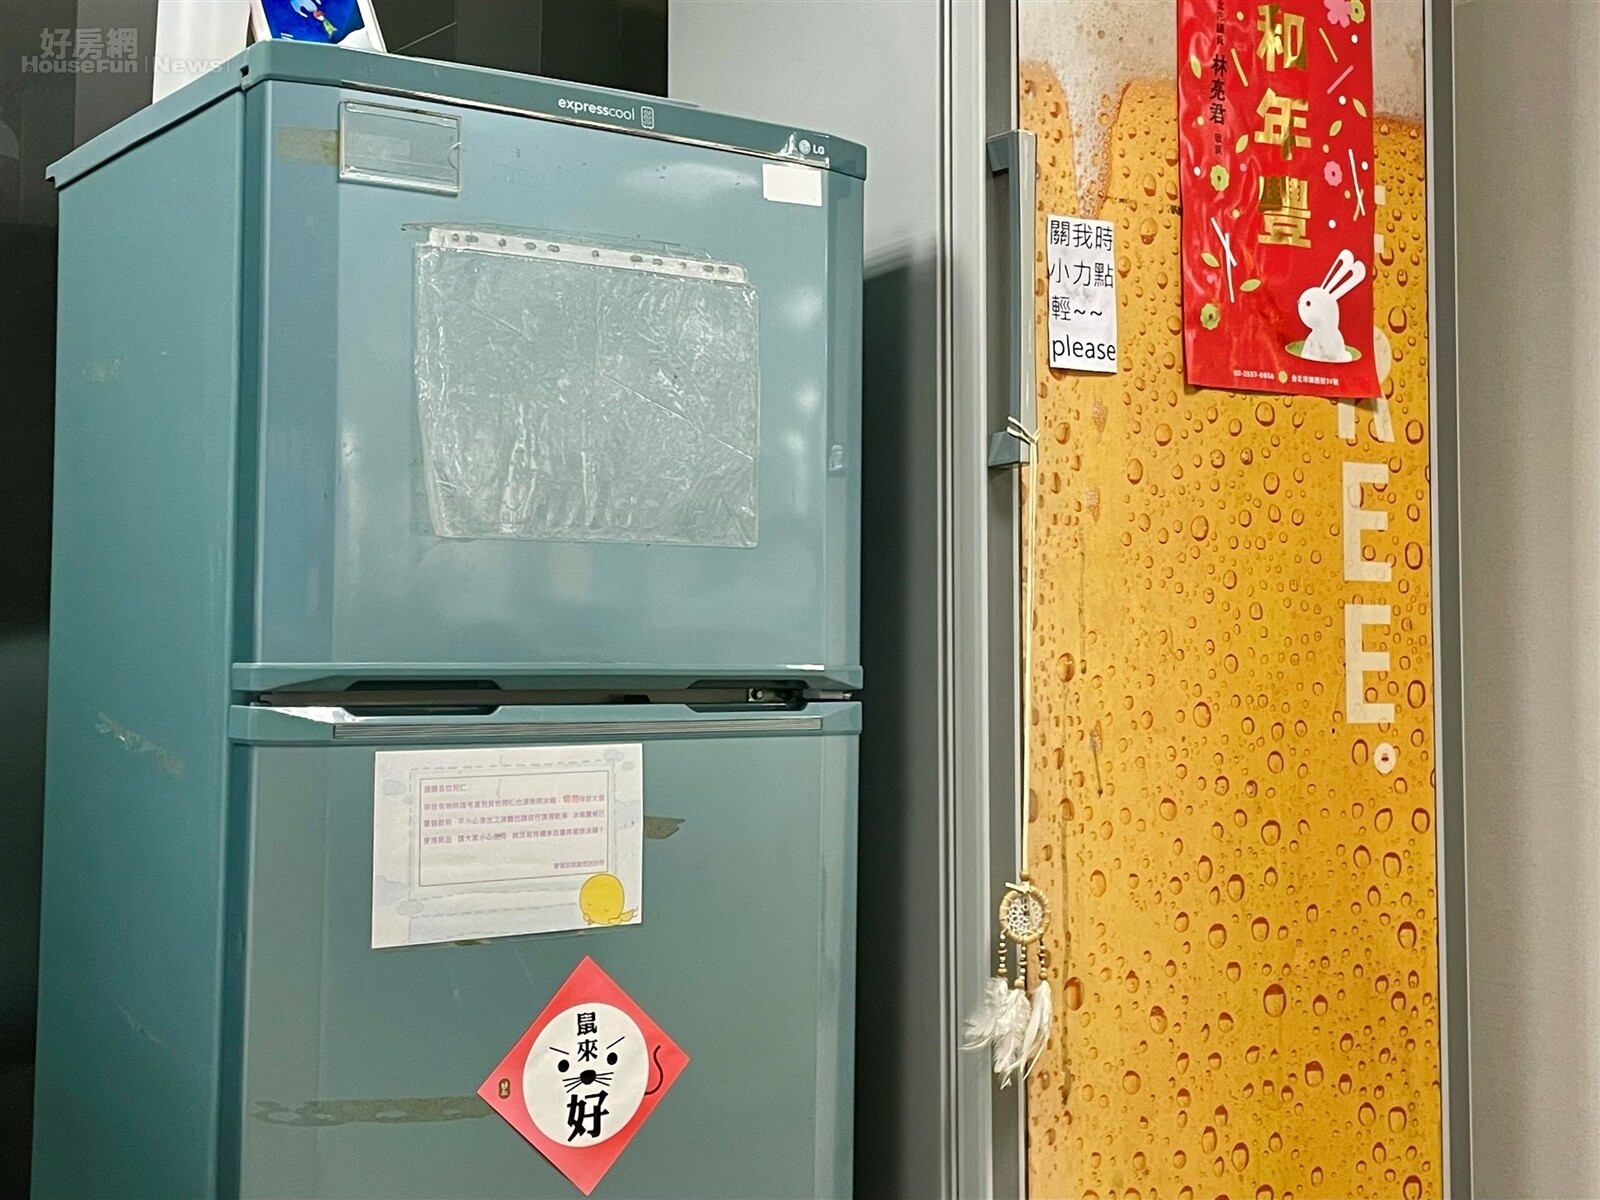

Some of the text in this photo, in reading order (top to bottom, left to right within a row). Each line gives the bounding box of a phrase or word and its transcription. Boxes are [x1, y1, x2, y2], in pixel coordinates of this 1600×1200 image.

[1209, 53, 1228, 126] 林亮君
[557, 98, 636, 121] expresscool
[1254, 4, 1312, 248] 和年豐
[812, 144, 825, 155] LG
[1050, 219, 1113, 252] 關我時
[1050, 258, 1114, 289] 小力點
[1052, 333, 1116, 362] please
[566, 1011, 610, 1142] 鼠來好
